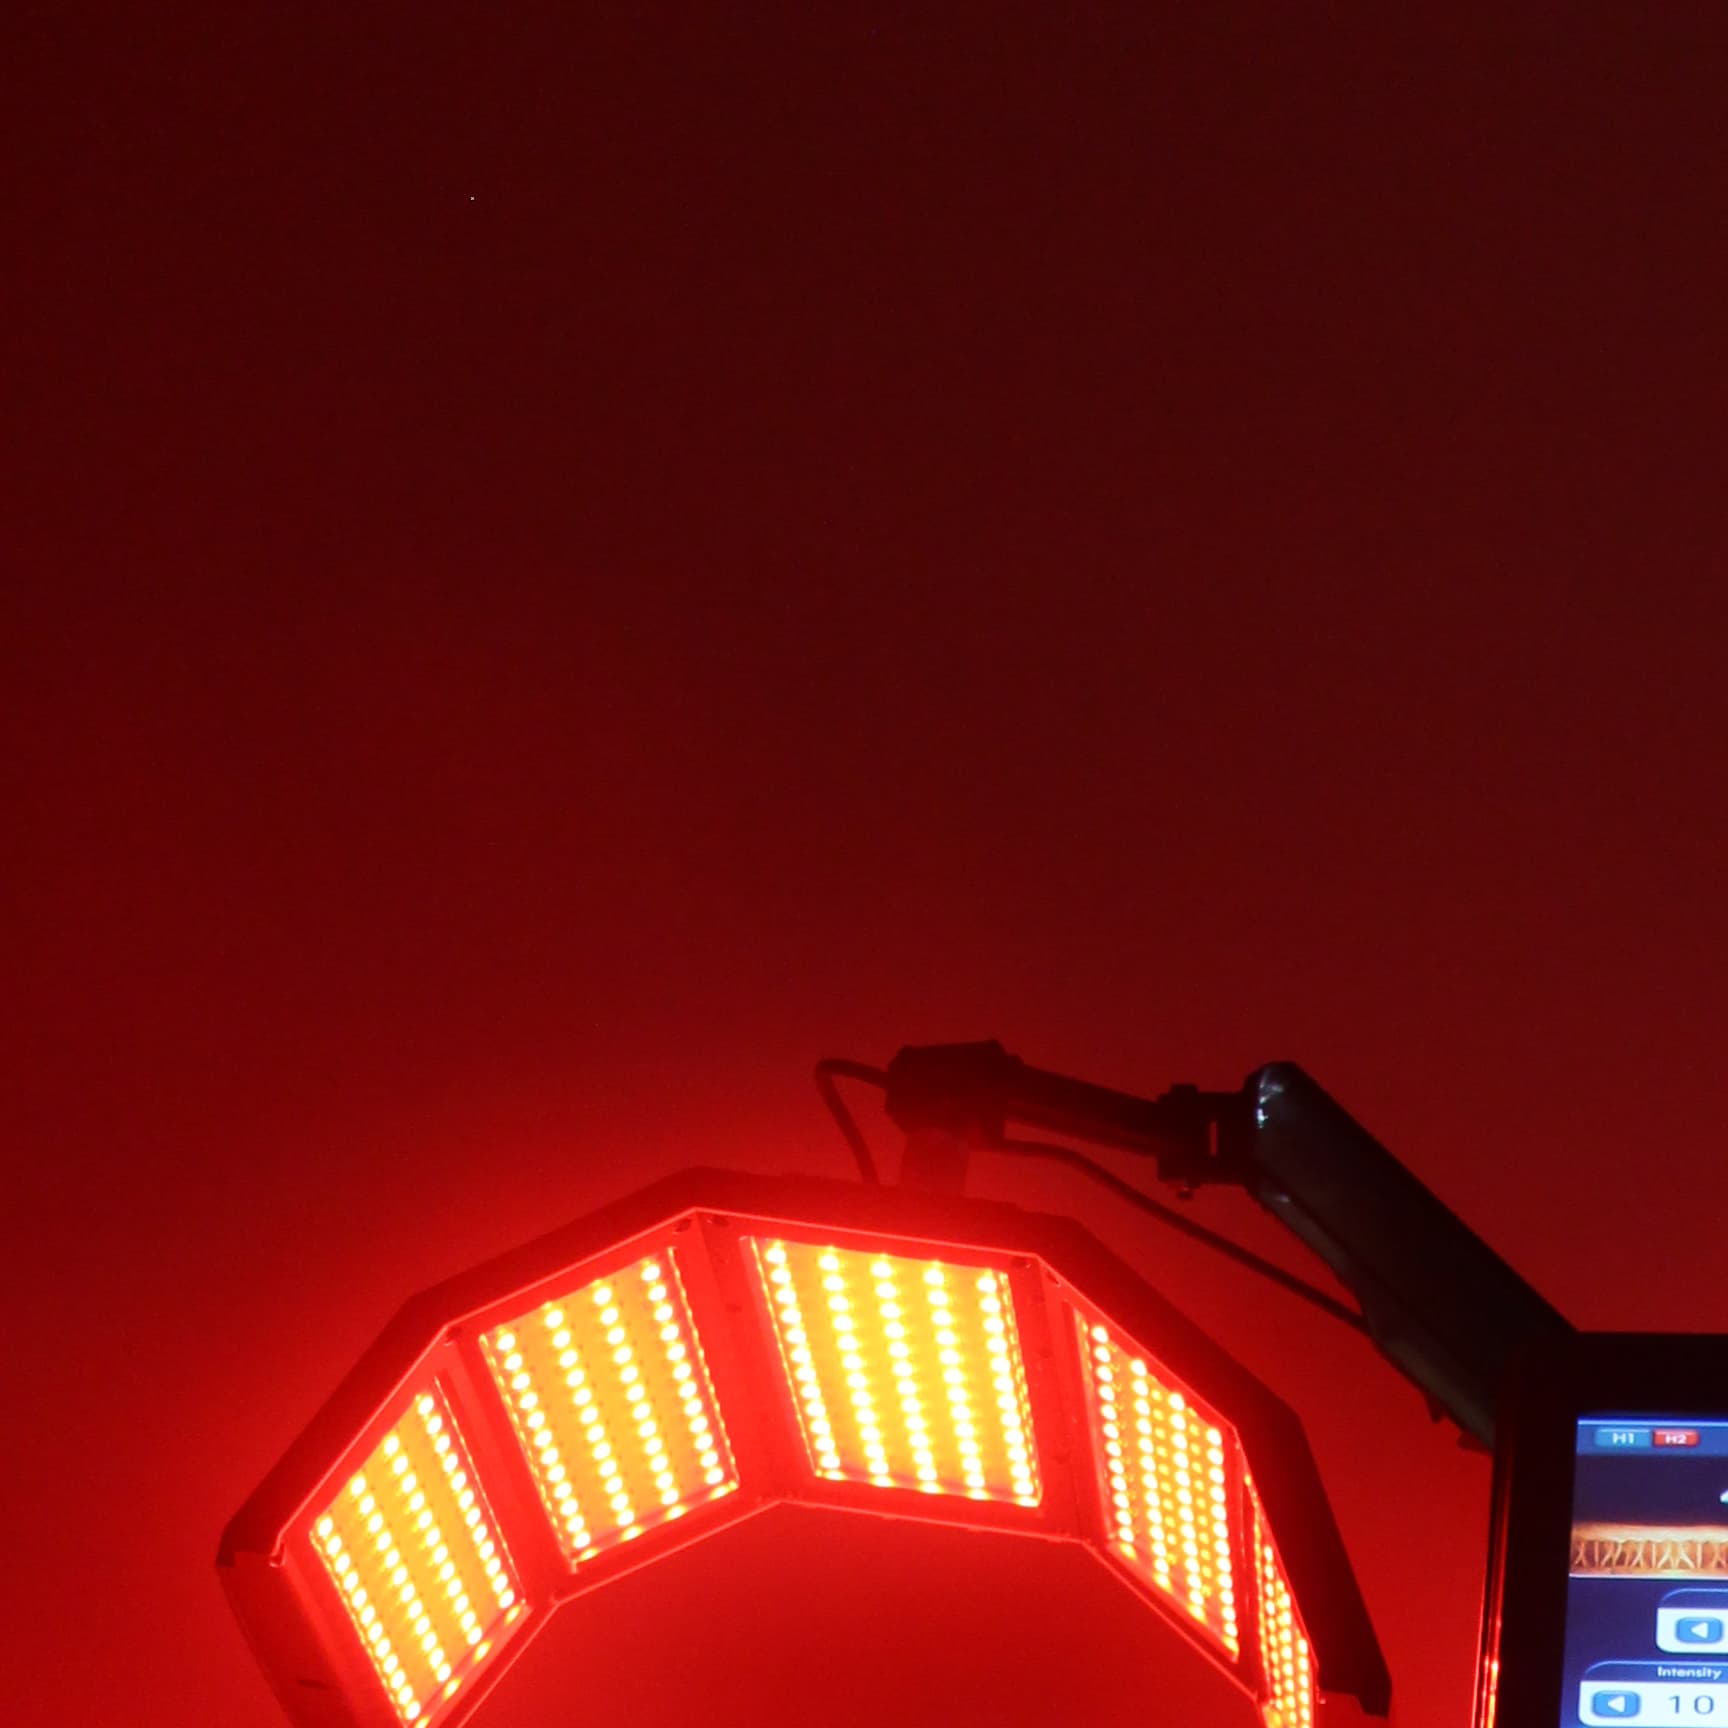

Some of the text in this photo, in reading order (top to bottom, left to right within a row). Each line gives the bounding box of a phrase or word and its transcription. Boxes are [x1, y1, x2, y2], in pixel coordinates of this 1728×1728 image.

[1612, 1432, 1635, 1445] H1
[1665, 1434, 1687, 1445] H2
[1657, 1665, 1722, 1681] Intensity
[1668, 1694, 1715, 1715] 10
